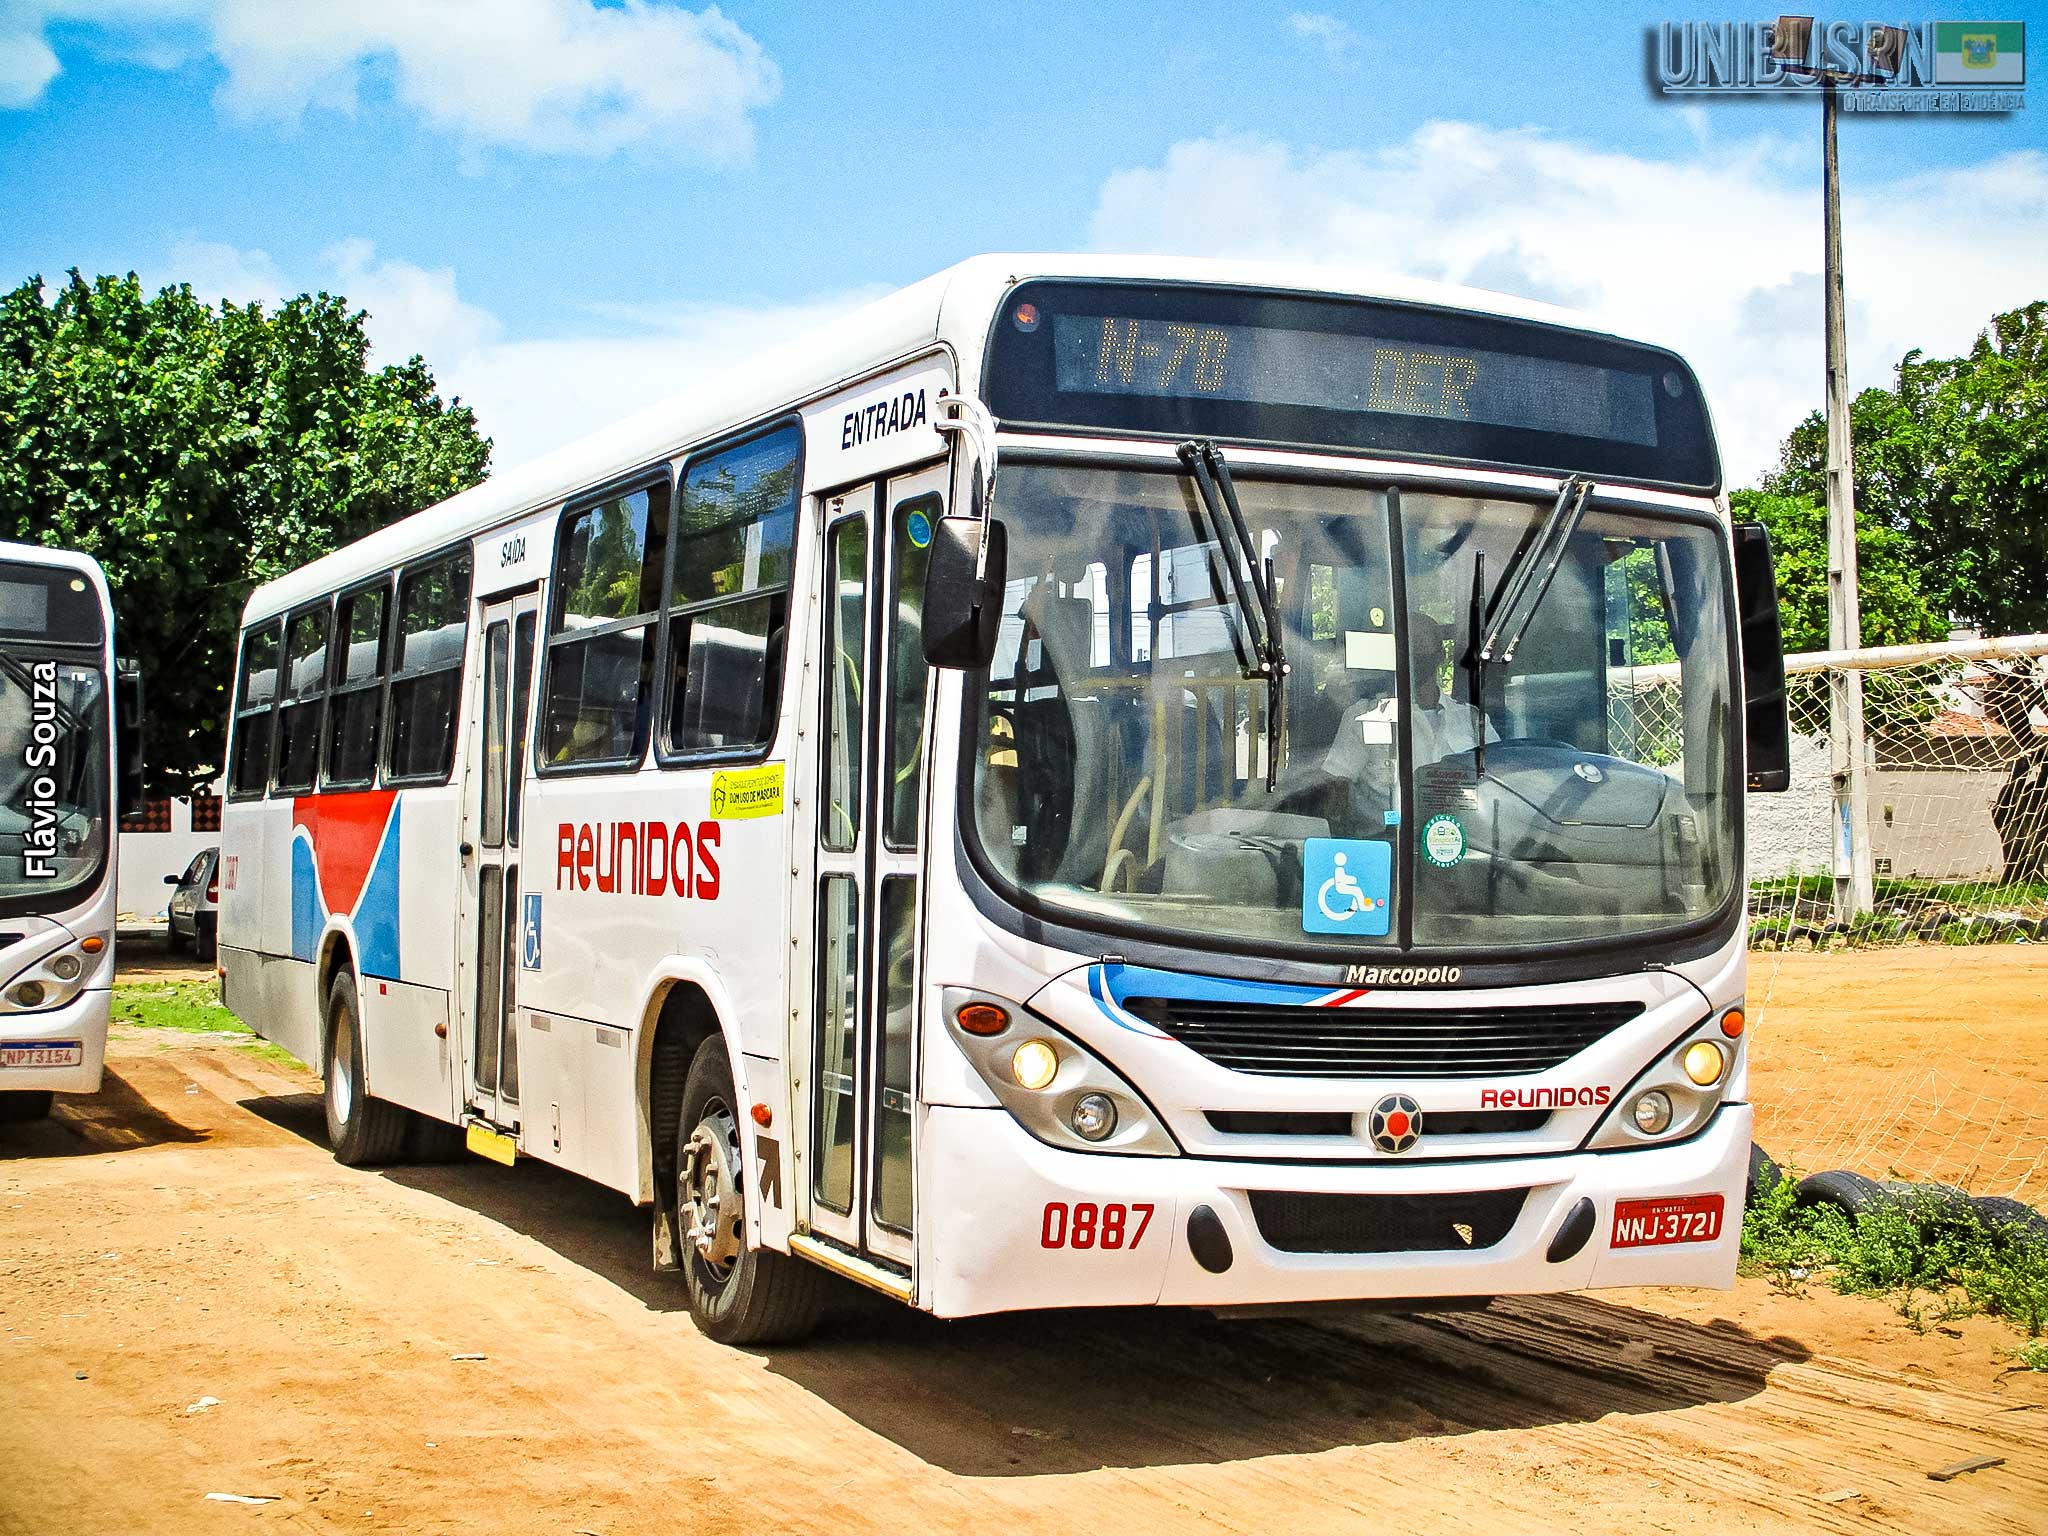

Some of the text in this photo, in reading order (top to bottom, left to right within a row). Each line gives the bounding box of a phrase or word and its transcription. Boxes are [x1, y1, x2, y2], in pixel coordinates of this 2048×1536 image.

[1368, 348, 1477, 418] DER
[842, 388, 926, 450] ENTRADA
[501, 533, 526, 568] SAÍDA
[1345, 965, 1461, 986] Marcopolo
[1041, 1202, 1155, 1250] 0887
